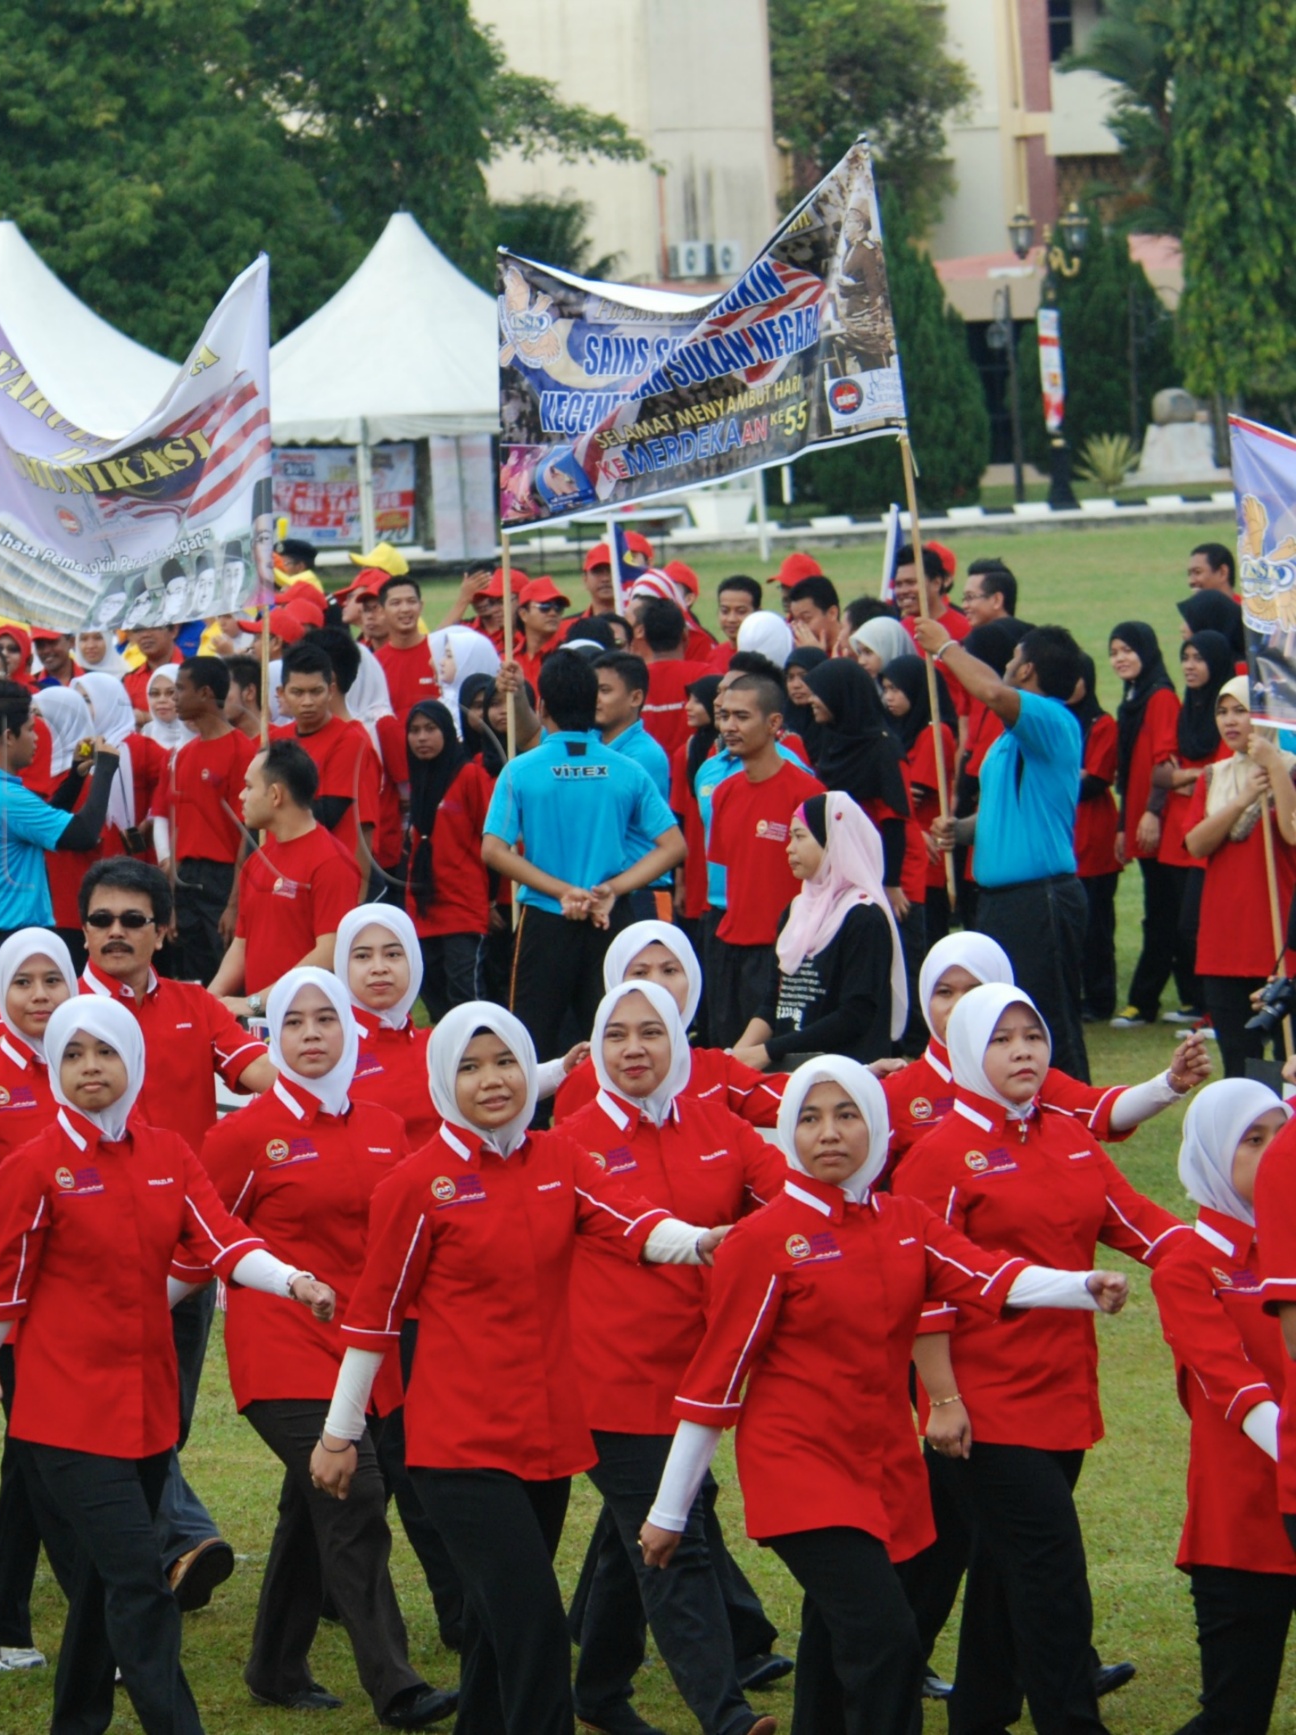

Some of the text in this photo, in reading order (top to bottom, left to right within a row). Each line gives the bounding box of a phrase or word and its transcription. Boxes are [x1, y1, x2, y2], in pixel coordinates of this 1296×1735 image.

[584, 333, 650, 377] SAINS
[667, 329, 757, 387] SUKAN
[747, 303, 820, 363] NEGARA
[594, 413, 674, 449] SELAMAT
[678, 385, 771, 428] MENYAMBUT
[774, 374, 802, 399] HARI
[783, 400, 808, 436] 55
[551, 763, 609, 779] VITEX
